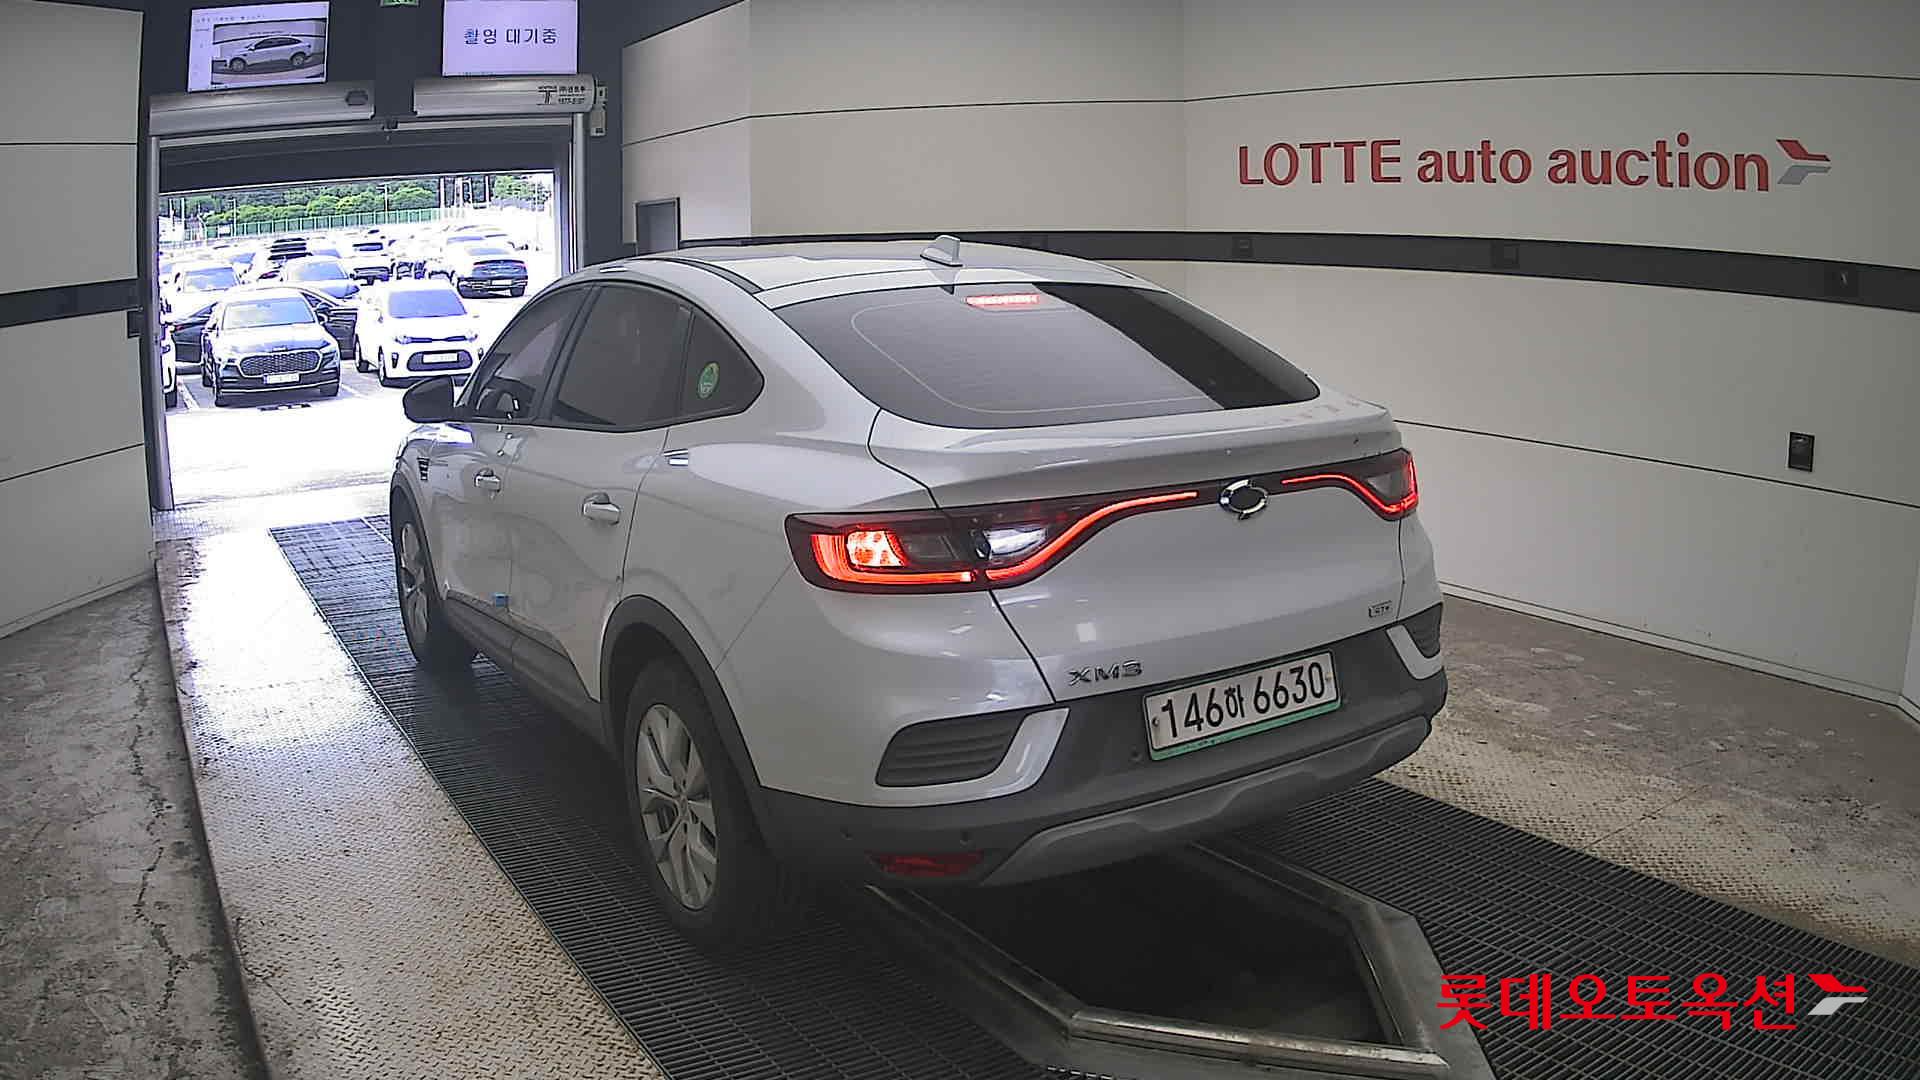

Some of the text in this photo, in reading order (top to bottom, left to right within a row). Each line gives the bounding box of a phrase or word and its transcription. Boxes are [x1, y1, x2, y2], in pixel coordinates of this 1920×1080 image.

[506, 28, 556, 45] 대기중
[1239, 131, 1771, 191] LOTTE auto auction
[1068, 659, 1143, 686] XM3
[1161, 661, 1326, 738] 146하 6630
